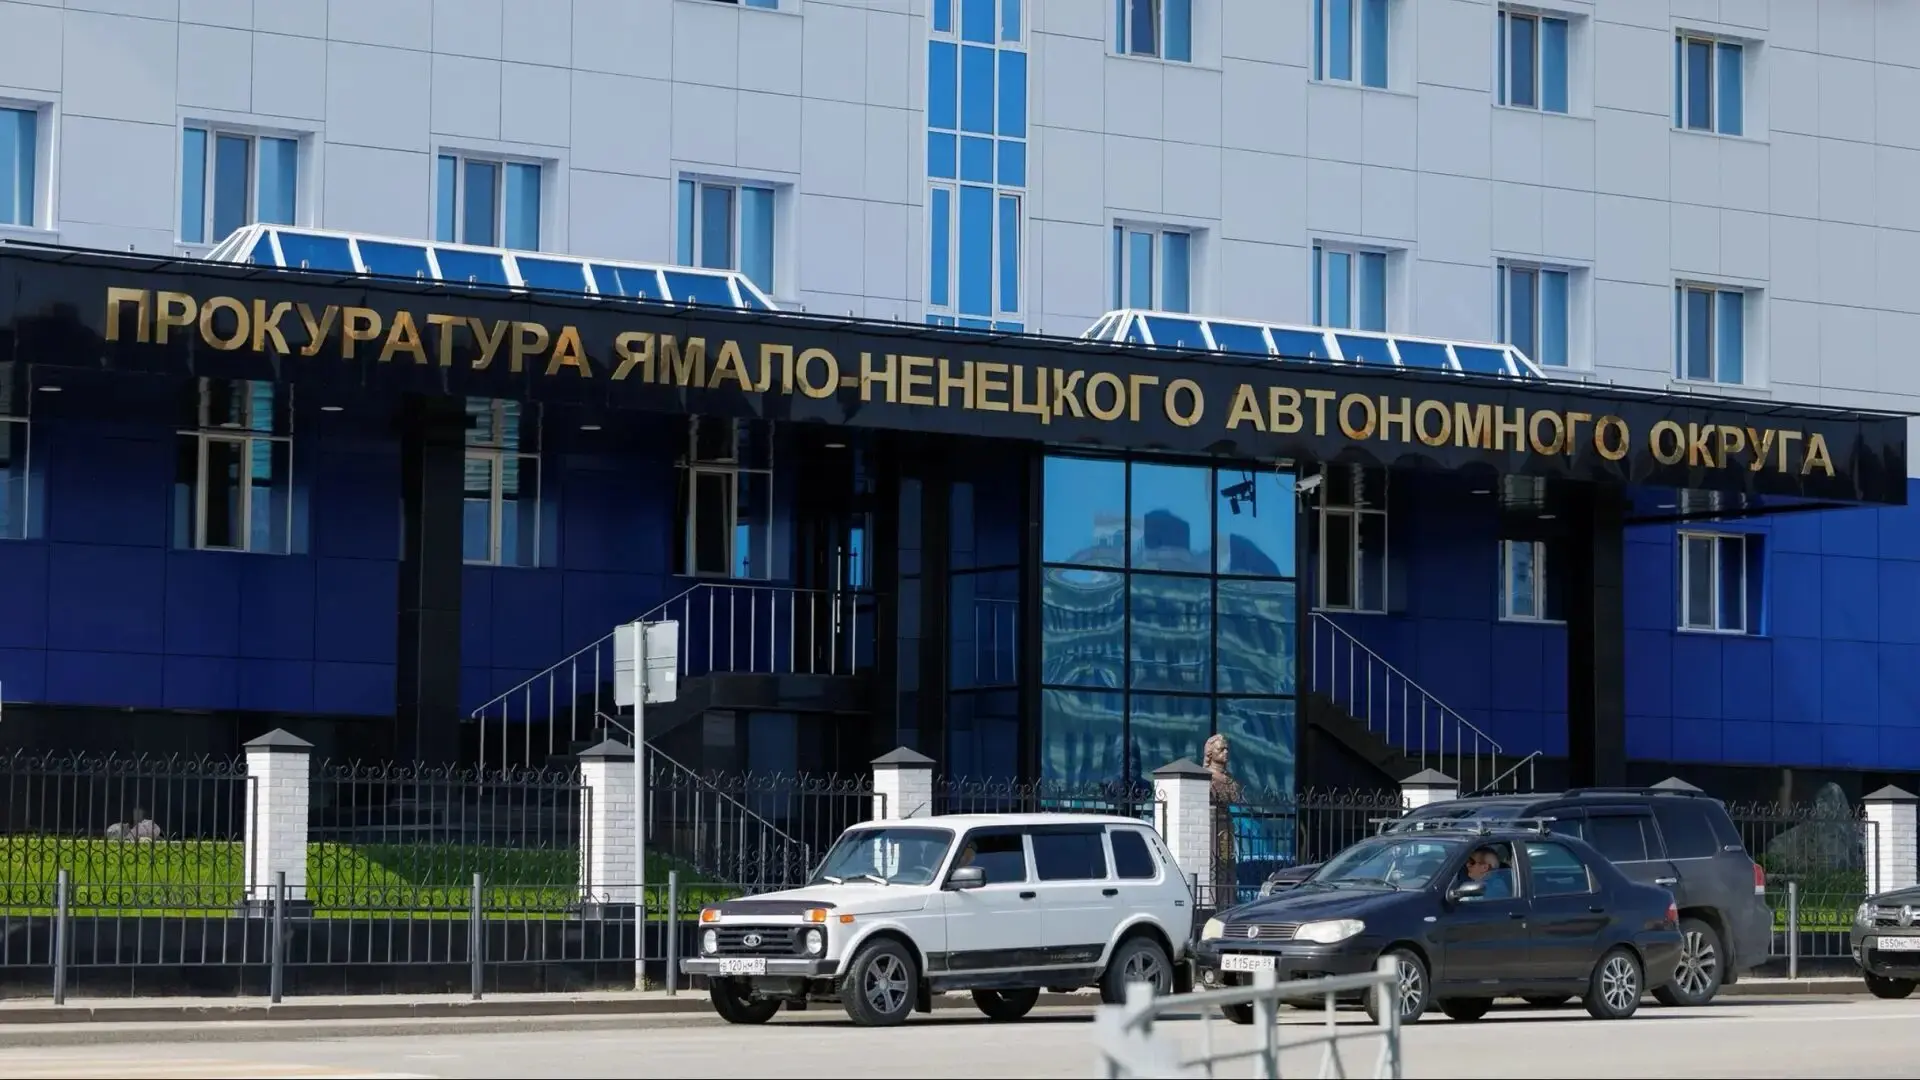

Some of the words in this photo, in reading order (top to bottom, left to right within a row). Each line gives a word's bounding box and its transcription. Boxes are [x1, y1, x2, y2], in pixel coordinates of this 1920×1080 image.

[105, 286, 593, 378] ПРОКУРАТУРА
[610, 330, 1205, 428] ЯМАЛО-НЕНЕЦКОГО
[1225, 382, 1630, 462] АВТОНОМНОГО
[1648, 419, 1835, 478] ОКРУГА
